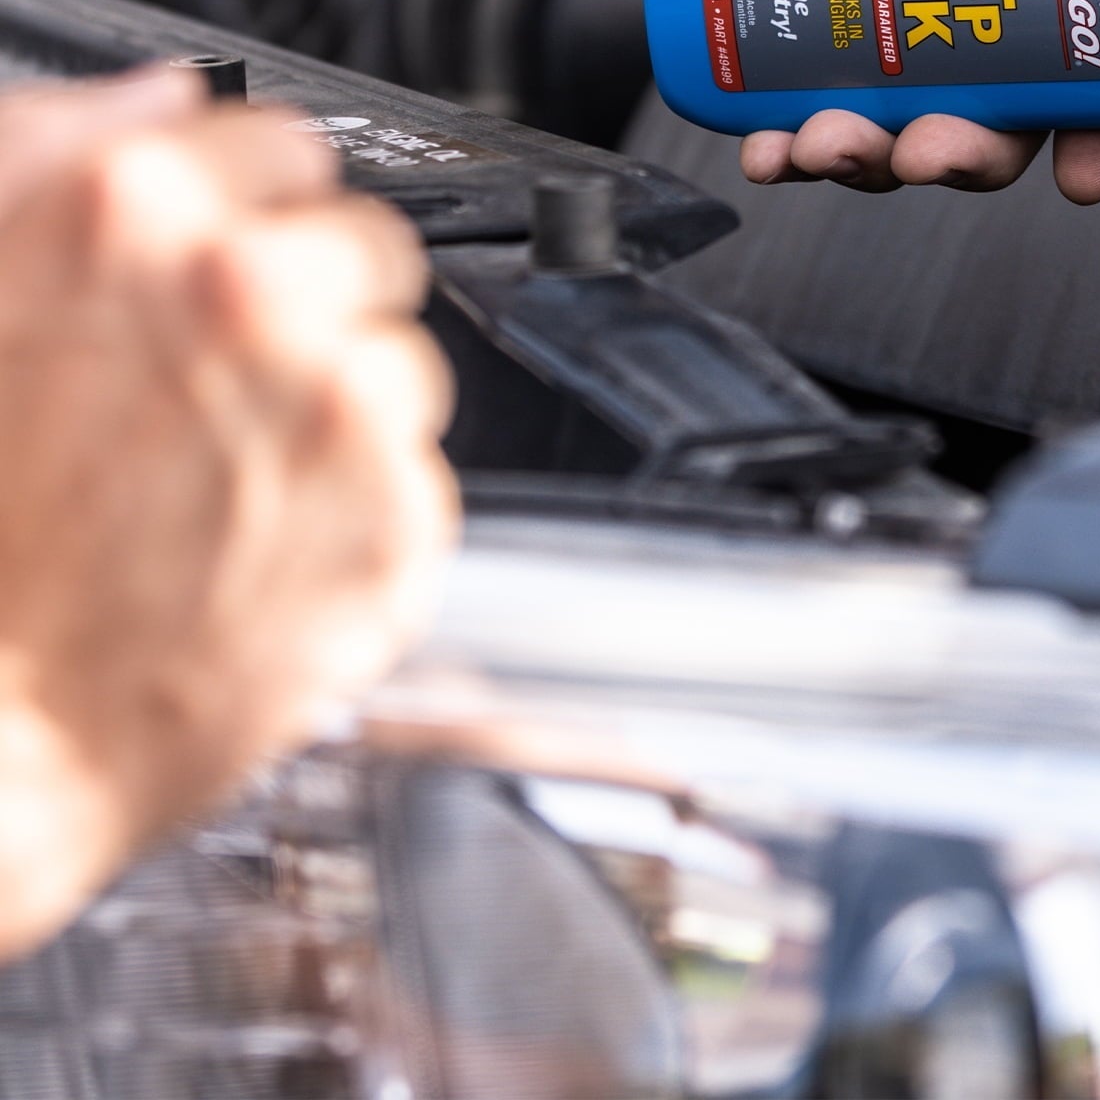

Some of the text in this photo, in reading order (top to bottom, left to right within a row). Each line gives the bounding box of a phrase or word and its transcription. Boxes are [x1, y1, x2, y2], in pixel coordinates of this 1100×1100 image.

[745, 0, 756, 26] Aceite
[713, 16, 727, 45] PART
[847, 23, 864, 40] IN
[717, 46, 733, 85] #49499
